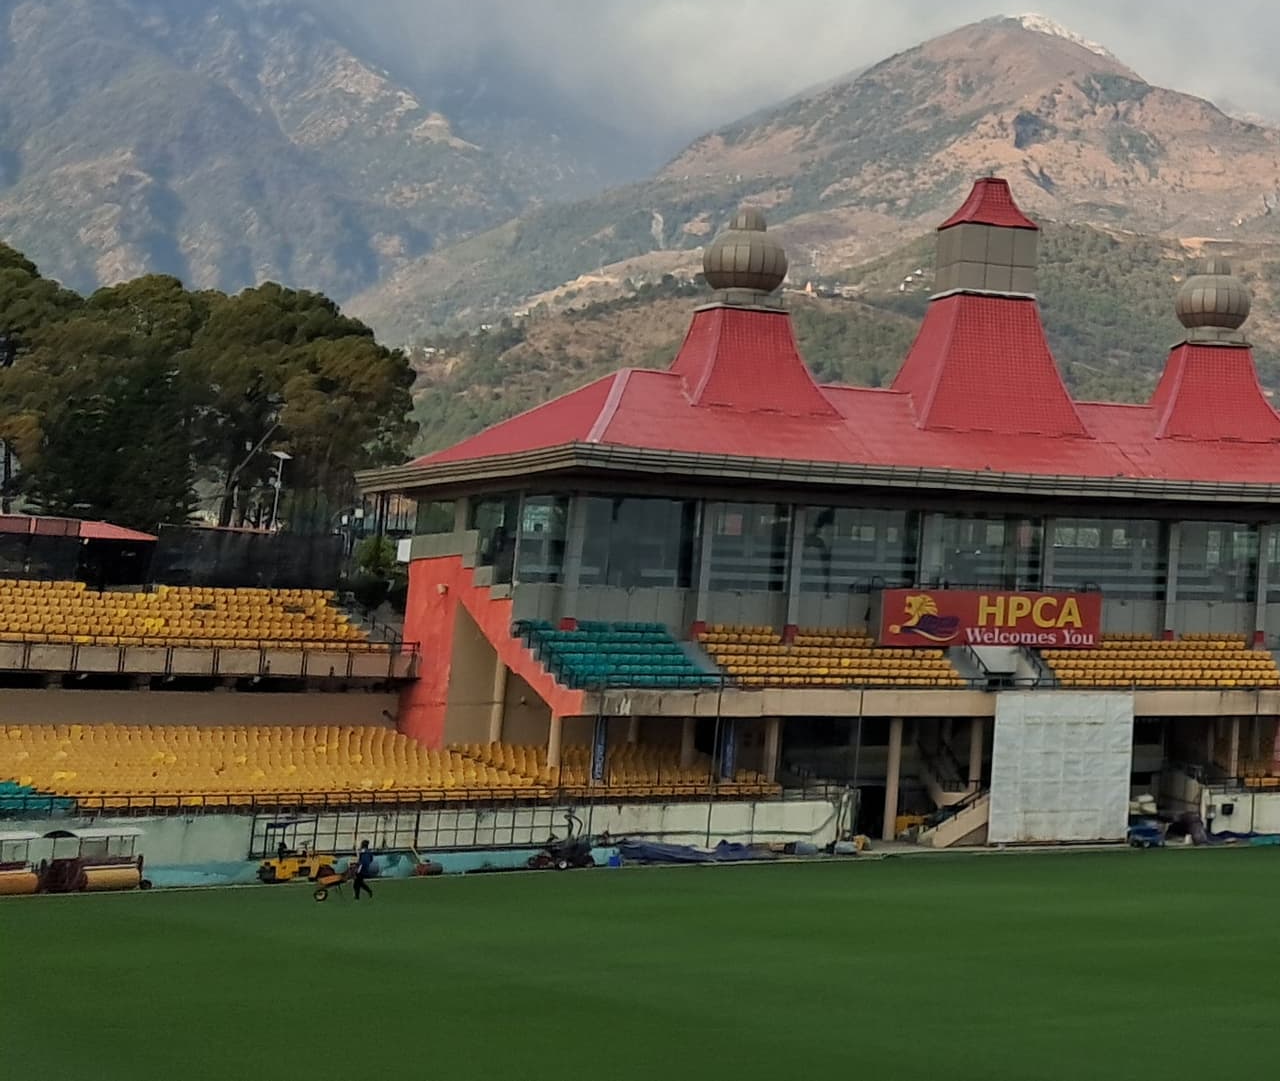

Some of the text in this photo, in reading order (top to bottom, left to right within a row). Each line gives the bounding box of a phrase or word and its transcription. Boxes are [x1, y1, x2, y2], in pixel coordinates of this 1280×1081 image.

[977, 595, 1082, 628] HPCA
[965, 627, 1094, 645] Welcomes You
